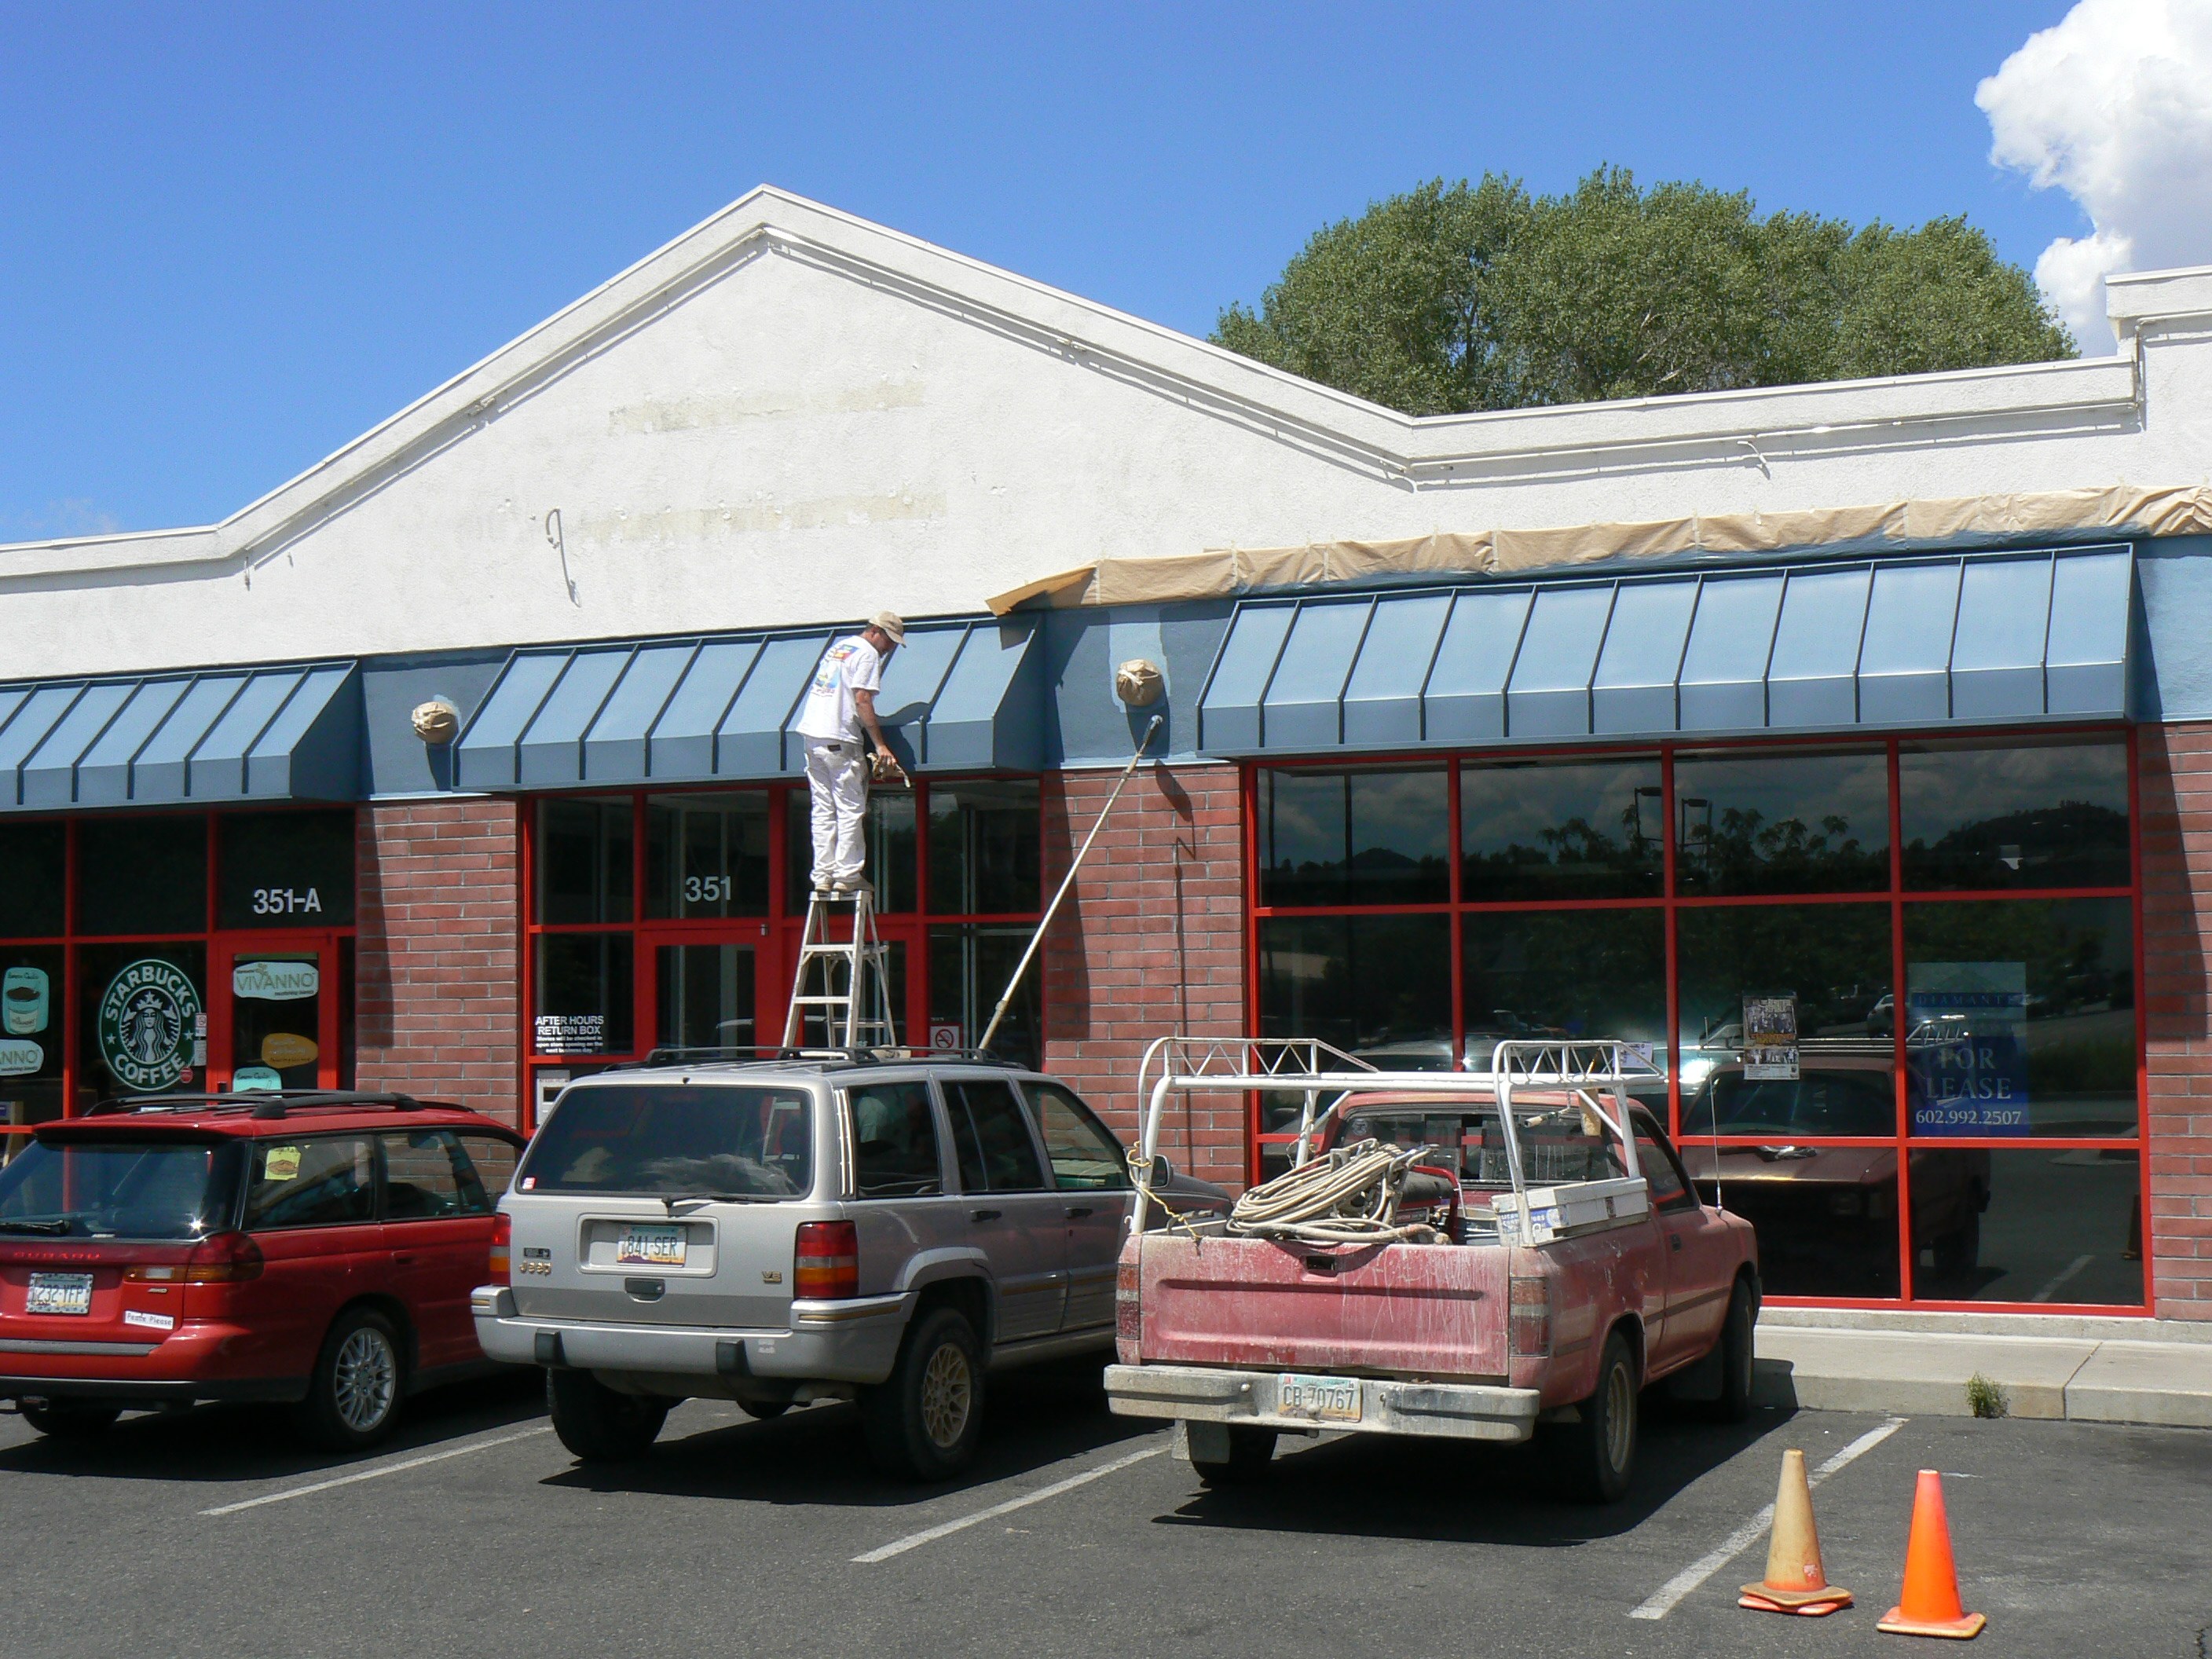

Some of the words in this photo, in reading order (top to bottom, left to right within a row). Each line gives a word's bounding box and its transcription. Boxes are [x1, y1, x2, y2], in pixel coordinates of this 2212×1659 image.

[684, 875, 731, 903] 351
[253, 888, 322, 914] 351-A
[236, 972, 314, 991] VIVANNO
[105, 965, 196, 1021] STARBUCKS
[536, 1016, 567, 1025] AFTER
[569, 1015, 604, 1025] HOURS
[538, 1026, 577, 1035] RETURN
[579, 1025, 601, 1035] BOX
[1937, 1047, 1996, 1069] FOR
[115, 1052, 185, 1085] COFFEE
[1926, 1077, 2012, 1100] LEASE
[1916, 1110, 2022, 1125] 602.992.2507
[519, 1260, 553, 1276] Jeep
[149, 1316, 172, 1326] Please
